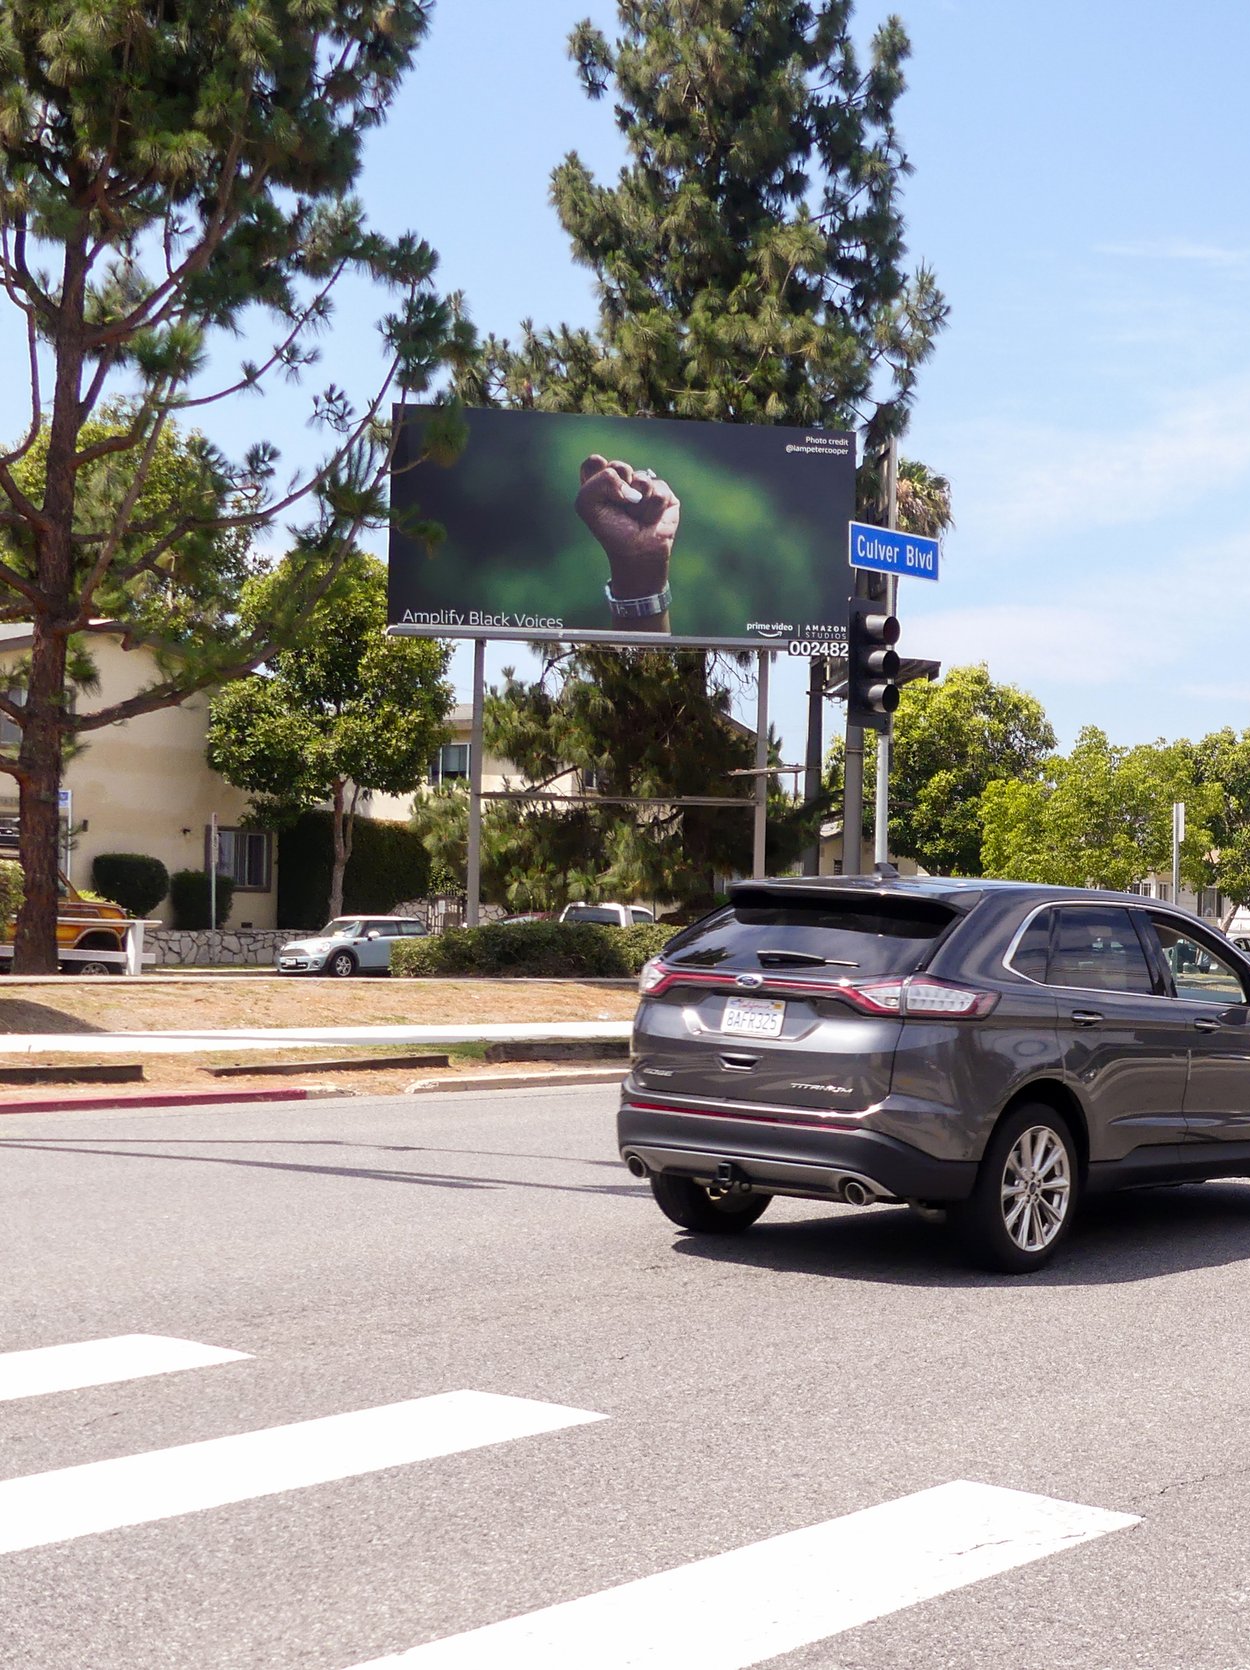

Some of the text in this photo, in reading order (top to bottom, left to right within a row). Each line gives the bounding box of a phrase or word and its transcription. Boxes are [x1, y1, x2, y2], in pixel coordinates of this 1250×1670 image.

[805, 435, 849, 447] Photo credit
[857, 534, 933, 571] Culver Blvd
[402, 608, 564, 629] Amplify Black Voices
[746, 622, 847, 633] prime video AMAZON
[805, 631, 847, 640] STUDIOS
[789, 641, 849, 657] 002482
[726, 1010, 779, 1030] 8AFR325
